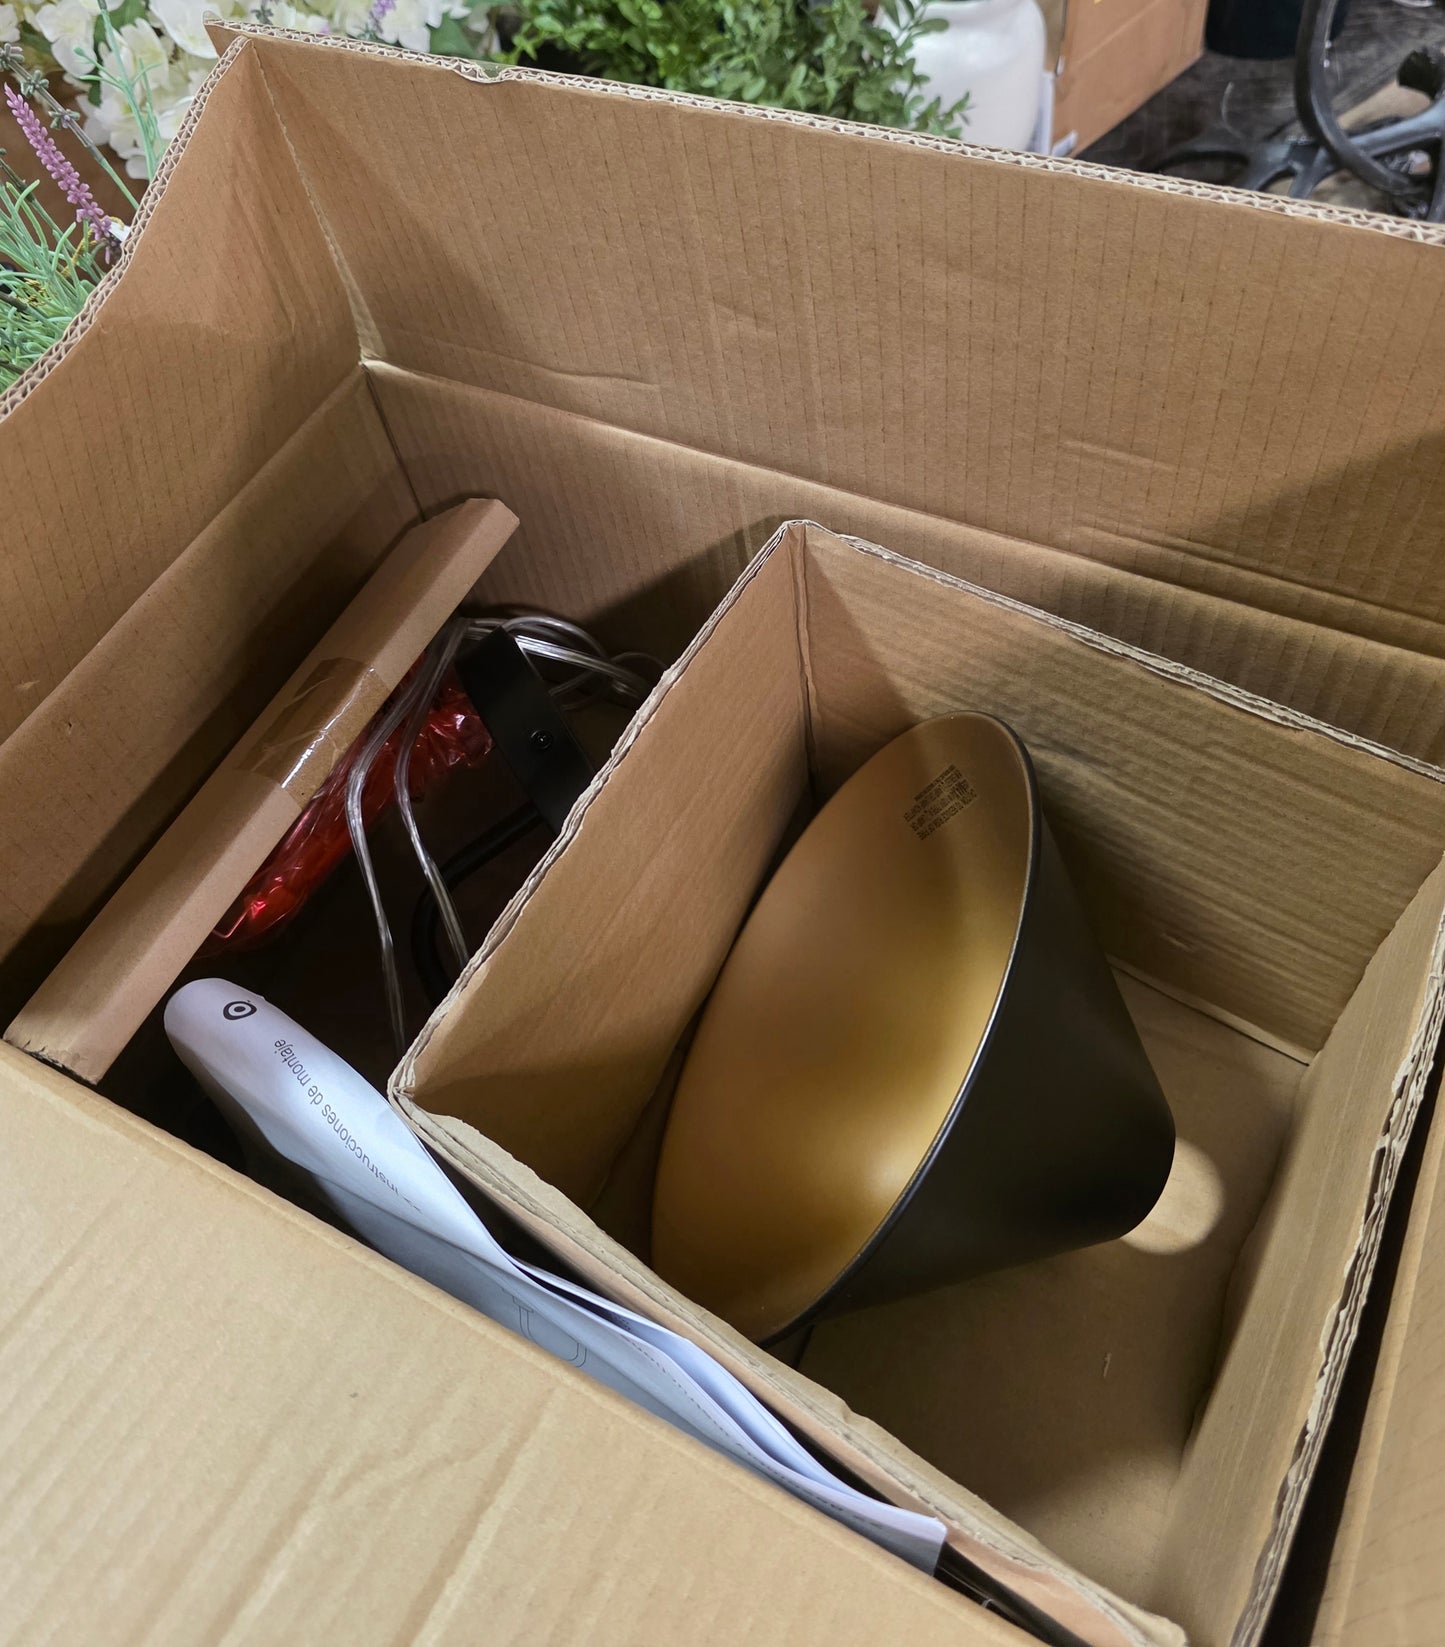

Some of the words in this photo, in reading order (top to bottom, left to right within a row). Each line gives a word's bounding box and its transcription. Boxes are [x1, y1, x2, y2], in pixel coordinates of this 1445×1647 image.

[273, 1038, 312, 1087] montaje
[307, 1085, 324, 1106] de
[321, 1104, 399, 1195] instrucciones
